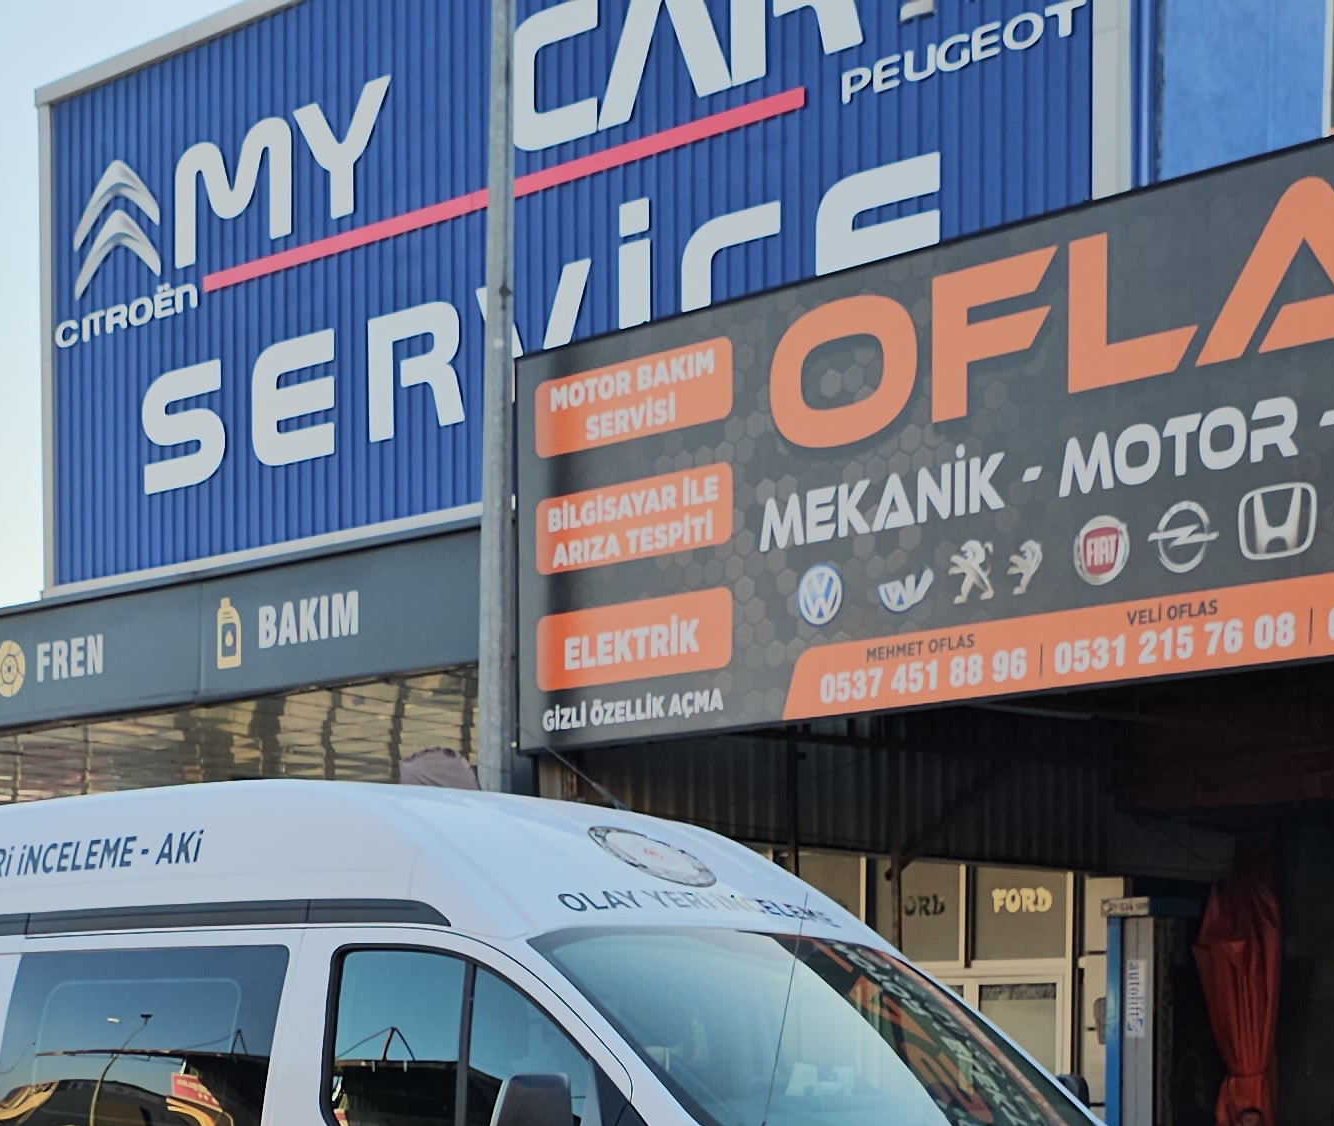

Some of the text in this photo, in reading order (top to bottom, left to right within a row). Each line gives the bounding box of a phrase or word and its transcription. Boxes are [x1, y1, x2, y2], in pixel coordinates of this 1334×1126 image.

[842, 1, 1085, 104] PEUGEOT
[175, 76, 391, 269] MY
[550, 349, 715, 412] MOTOR BAKIM
[585, 392, 676, 441] SERVİSİ
[759, 444, 1005, 551] MEKANİK
[1058, 395, 1299, 498] MOTOR
[547, 475, 720, 533] BİLGİSAYAR İLE
[552, 509, 713, 570] ARIZA TESPİTİ
[258, 590, 360, 649] BAKIM
[1127, 600, 1218, 626] VELİ OFLAS
[36, 634, 104, 683] FREN
[564, 617, 700, 670] ELEKTRİK
[867, 634, 976, 663] MEHMET OFLAS
[1054, 612, 1296, 676] 0531 215 76 08
[820, 648, 1027, 704] 0537 451 88 96
[543, 687, 724, 732] GİZLİ ÖZELLİK AÇMA
[557, 890, 642, 912] OLAY
[992, 886, 1052, 913] FORD
